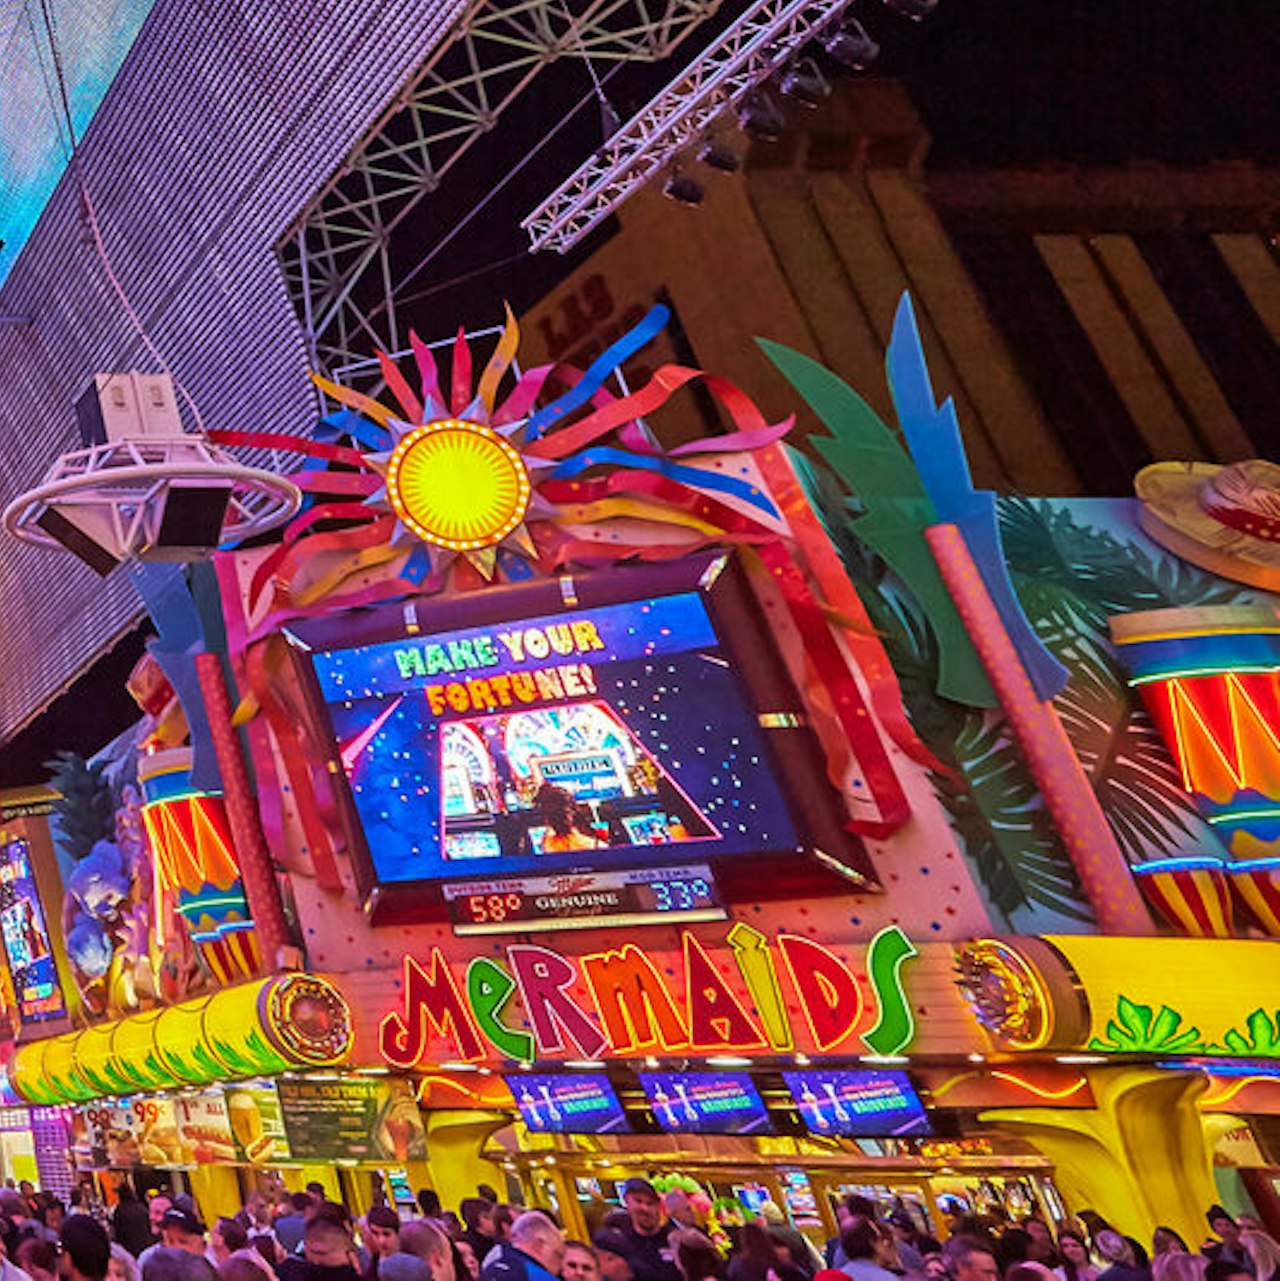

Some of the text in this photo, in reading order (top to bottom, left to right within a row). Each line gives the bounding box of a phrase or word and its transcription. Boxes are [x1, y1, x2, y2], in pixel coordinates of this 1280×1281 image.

[396, 621, 605, 678] MAKE YOUR
[425, 665, 598, 715] FORTUNE!
[534, 893, 620, 911] GENUINE
